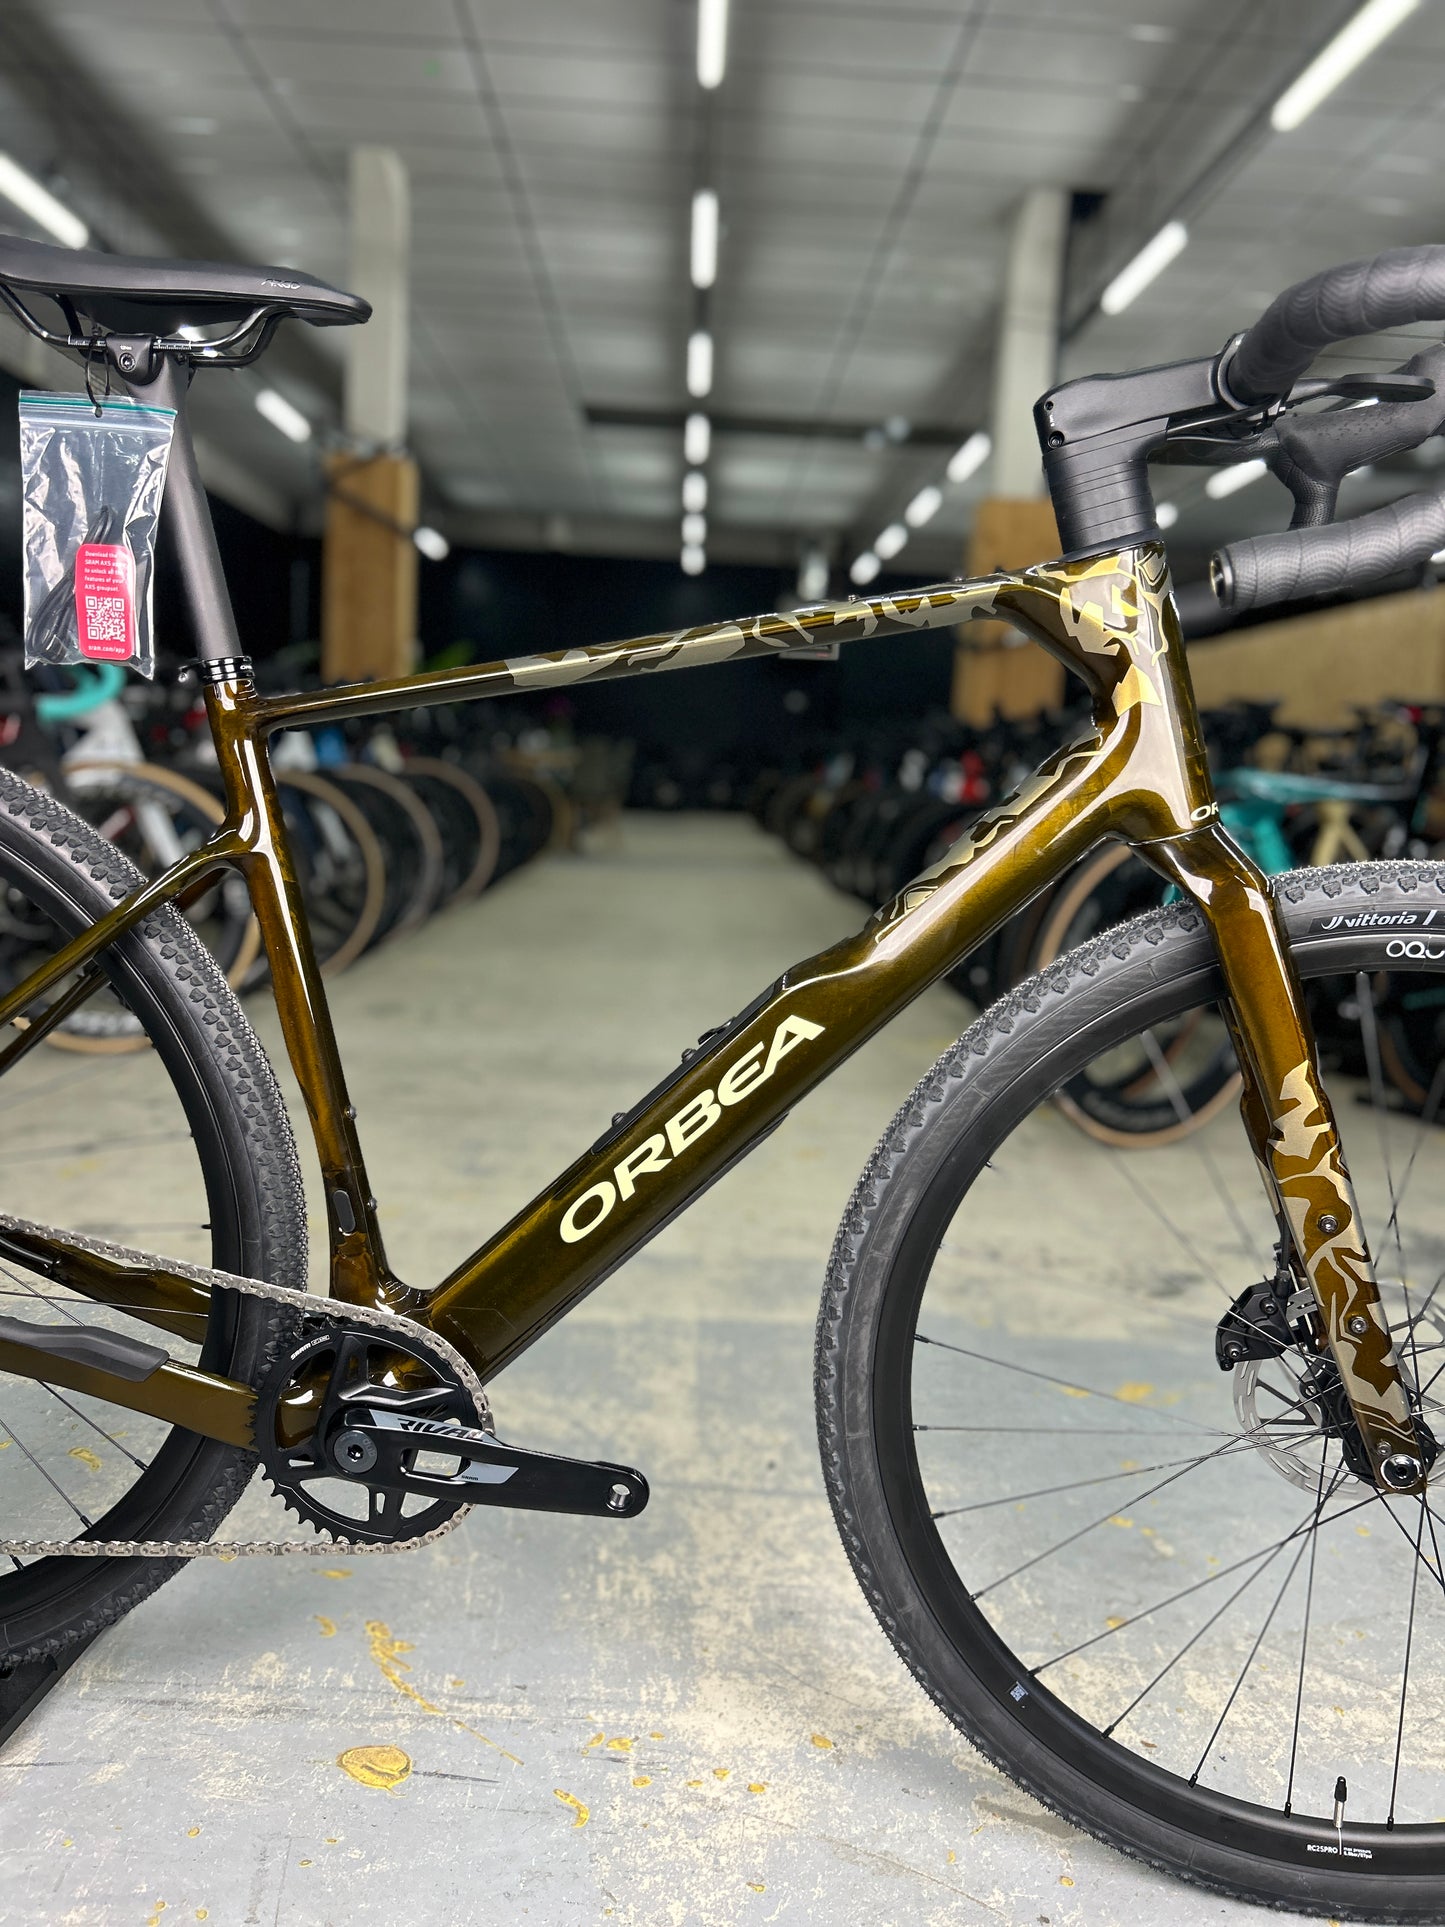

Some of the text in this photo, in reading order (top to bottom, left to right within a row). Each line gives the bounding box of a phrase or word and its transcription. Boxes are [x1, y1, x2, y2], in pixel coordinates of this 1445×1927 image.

[84, 550, 108, 558] Download
[88, 645, 125, 654] sram.com/app
[1344, 911, 1418, 928] vittoria
[559, 1013, 826, 1244] ORBEA
